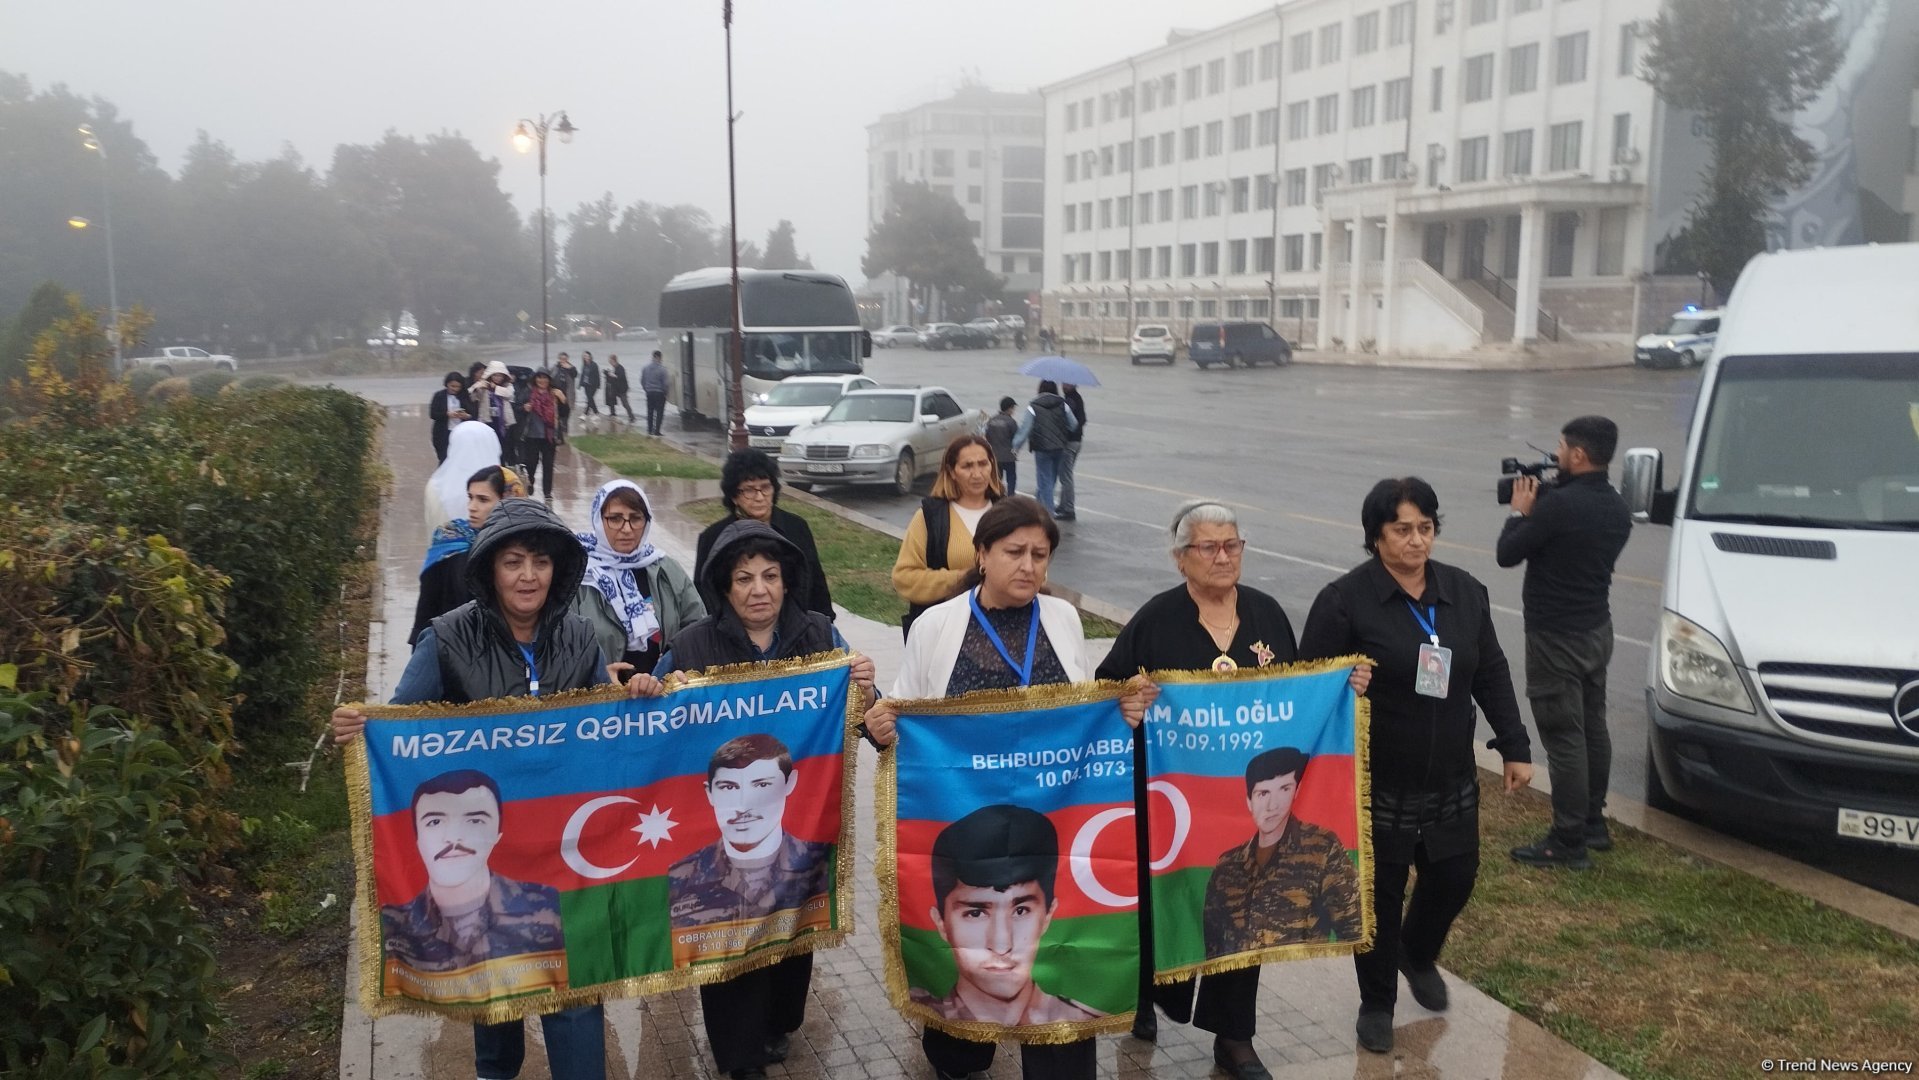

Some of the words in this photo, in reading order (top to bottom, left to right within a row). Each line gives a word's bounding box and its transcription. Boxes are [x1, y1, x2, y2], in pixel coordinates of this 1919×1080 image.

[391, 722, 567, 759] MƏZARSIZ
[575, 685, 828, 741] QƏHRƏMANLAR!
[1178, 702, 1231, 728] ADİL
[1235, 699, 1294, 725] OĞLU
[972, 746, 1083, 770] BEHBUDOV
